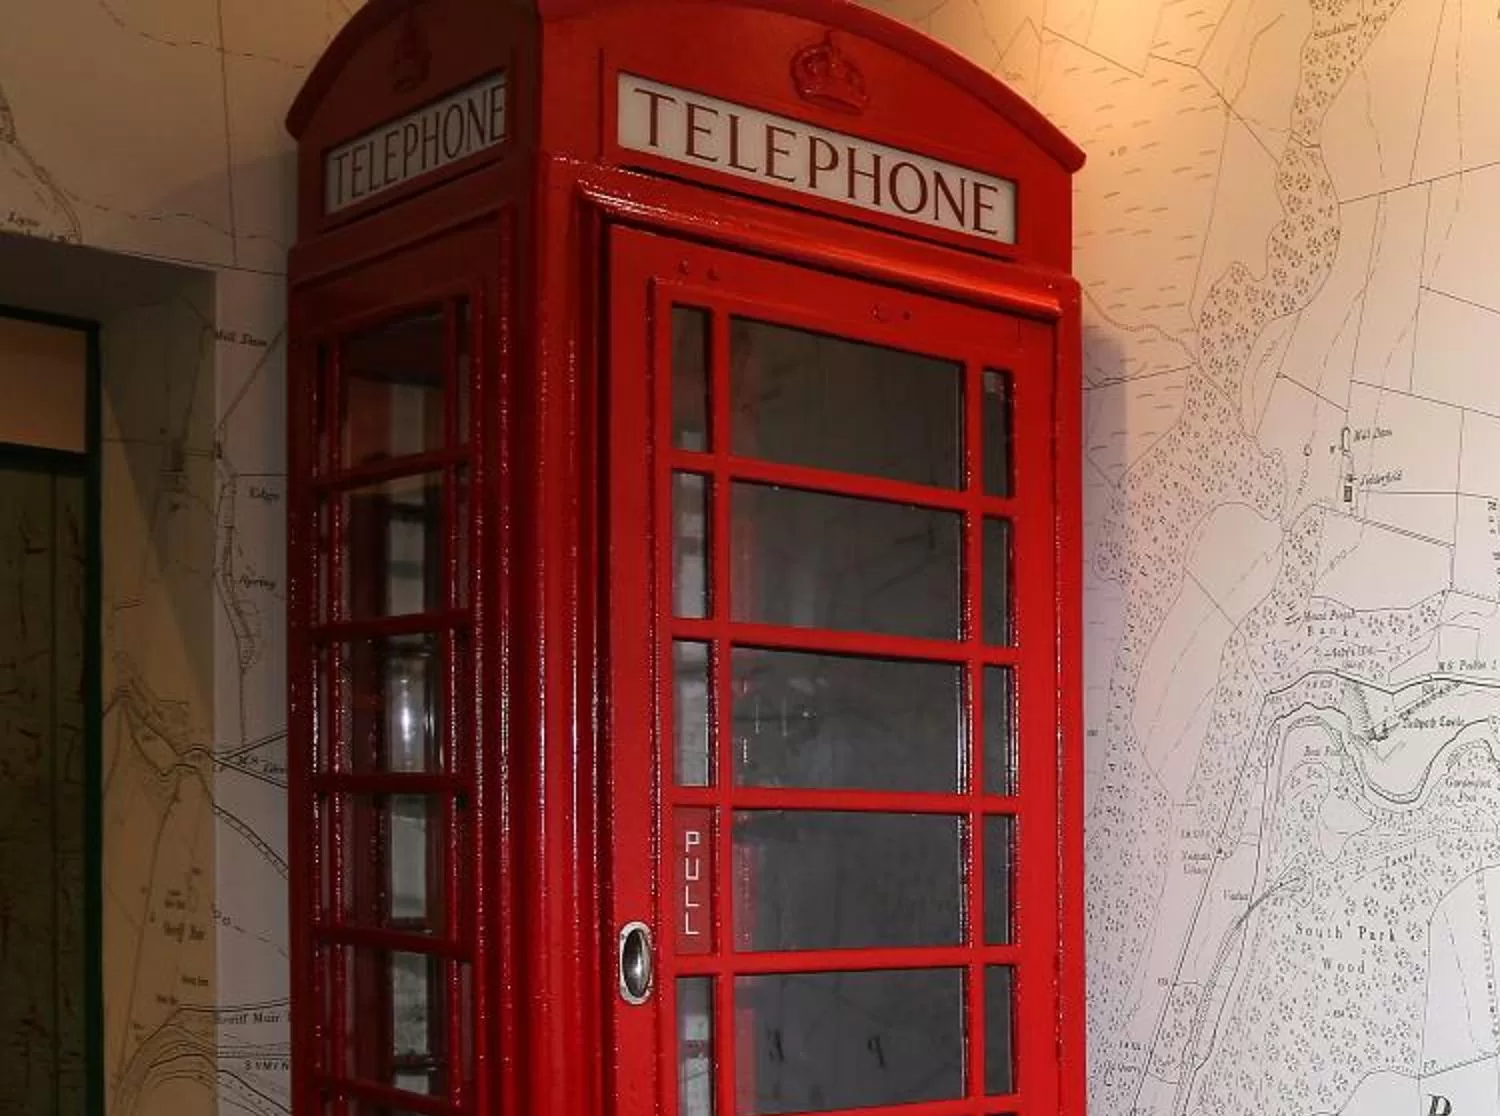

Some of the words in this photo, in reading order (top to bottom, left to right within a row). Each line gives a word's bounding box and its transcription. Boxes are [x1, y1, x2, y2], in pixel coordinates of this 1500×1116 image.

[332, 84, 508, 205] TELEPHONE
[633, 87, 999, 236] TELEPHONE
[684, 830, 701, 935] PULL
[1294, 922, 1344, 940] South
[1357, 924, 1395, 942] Park
[1321, 956, 1365, 974] Wood
